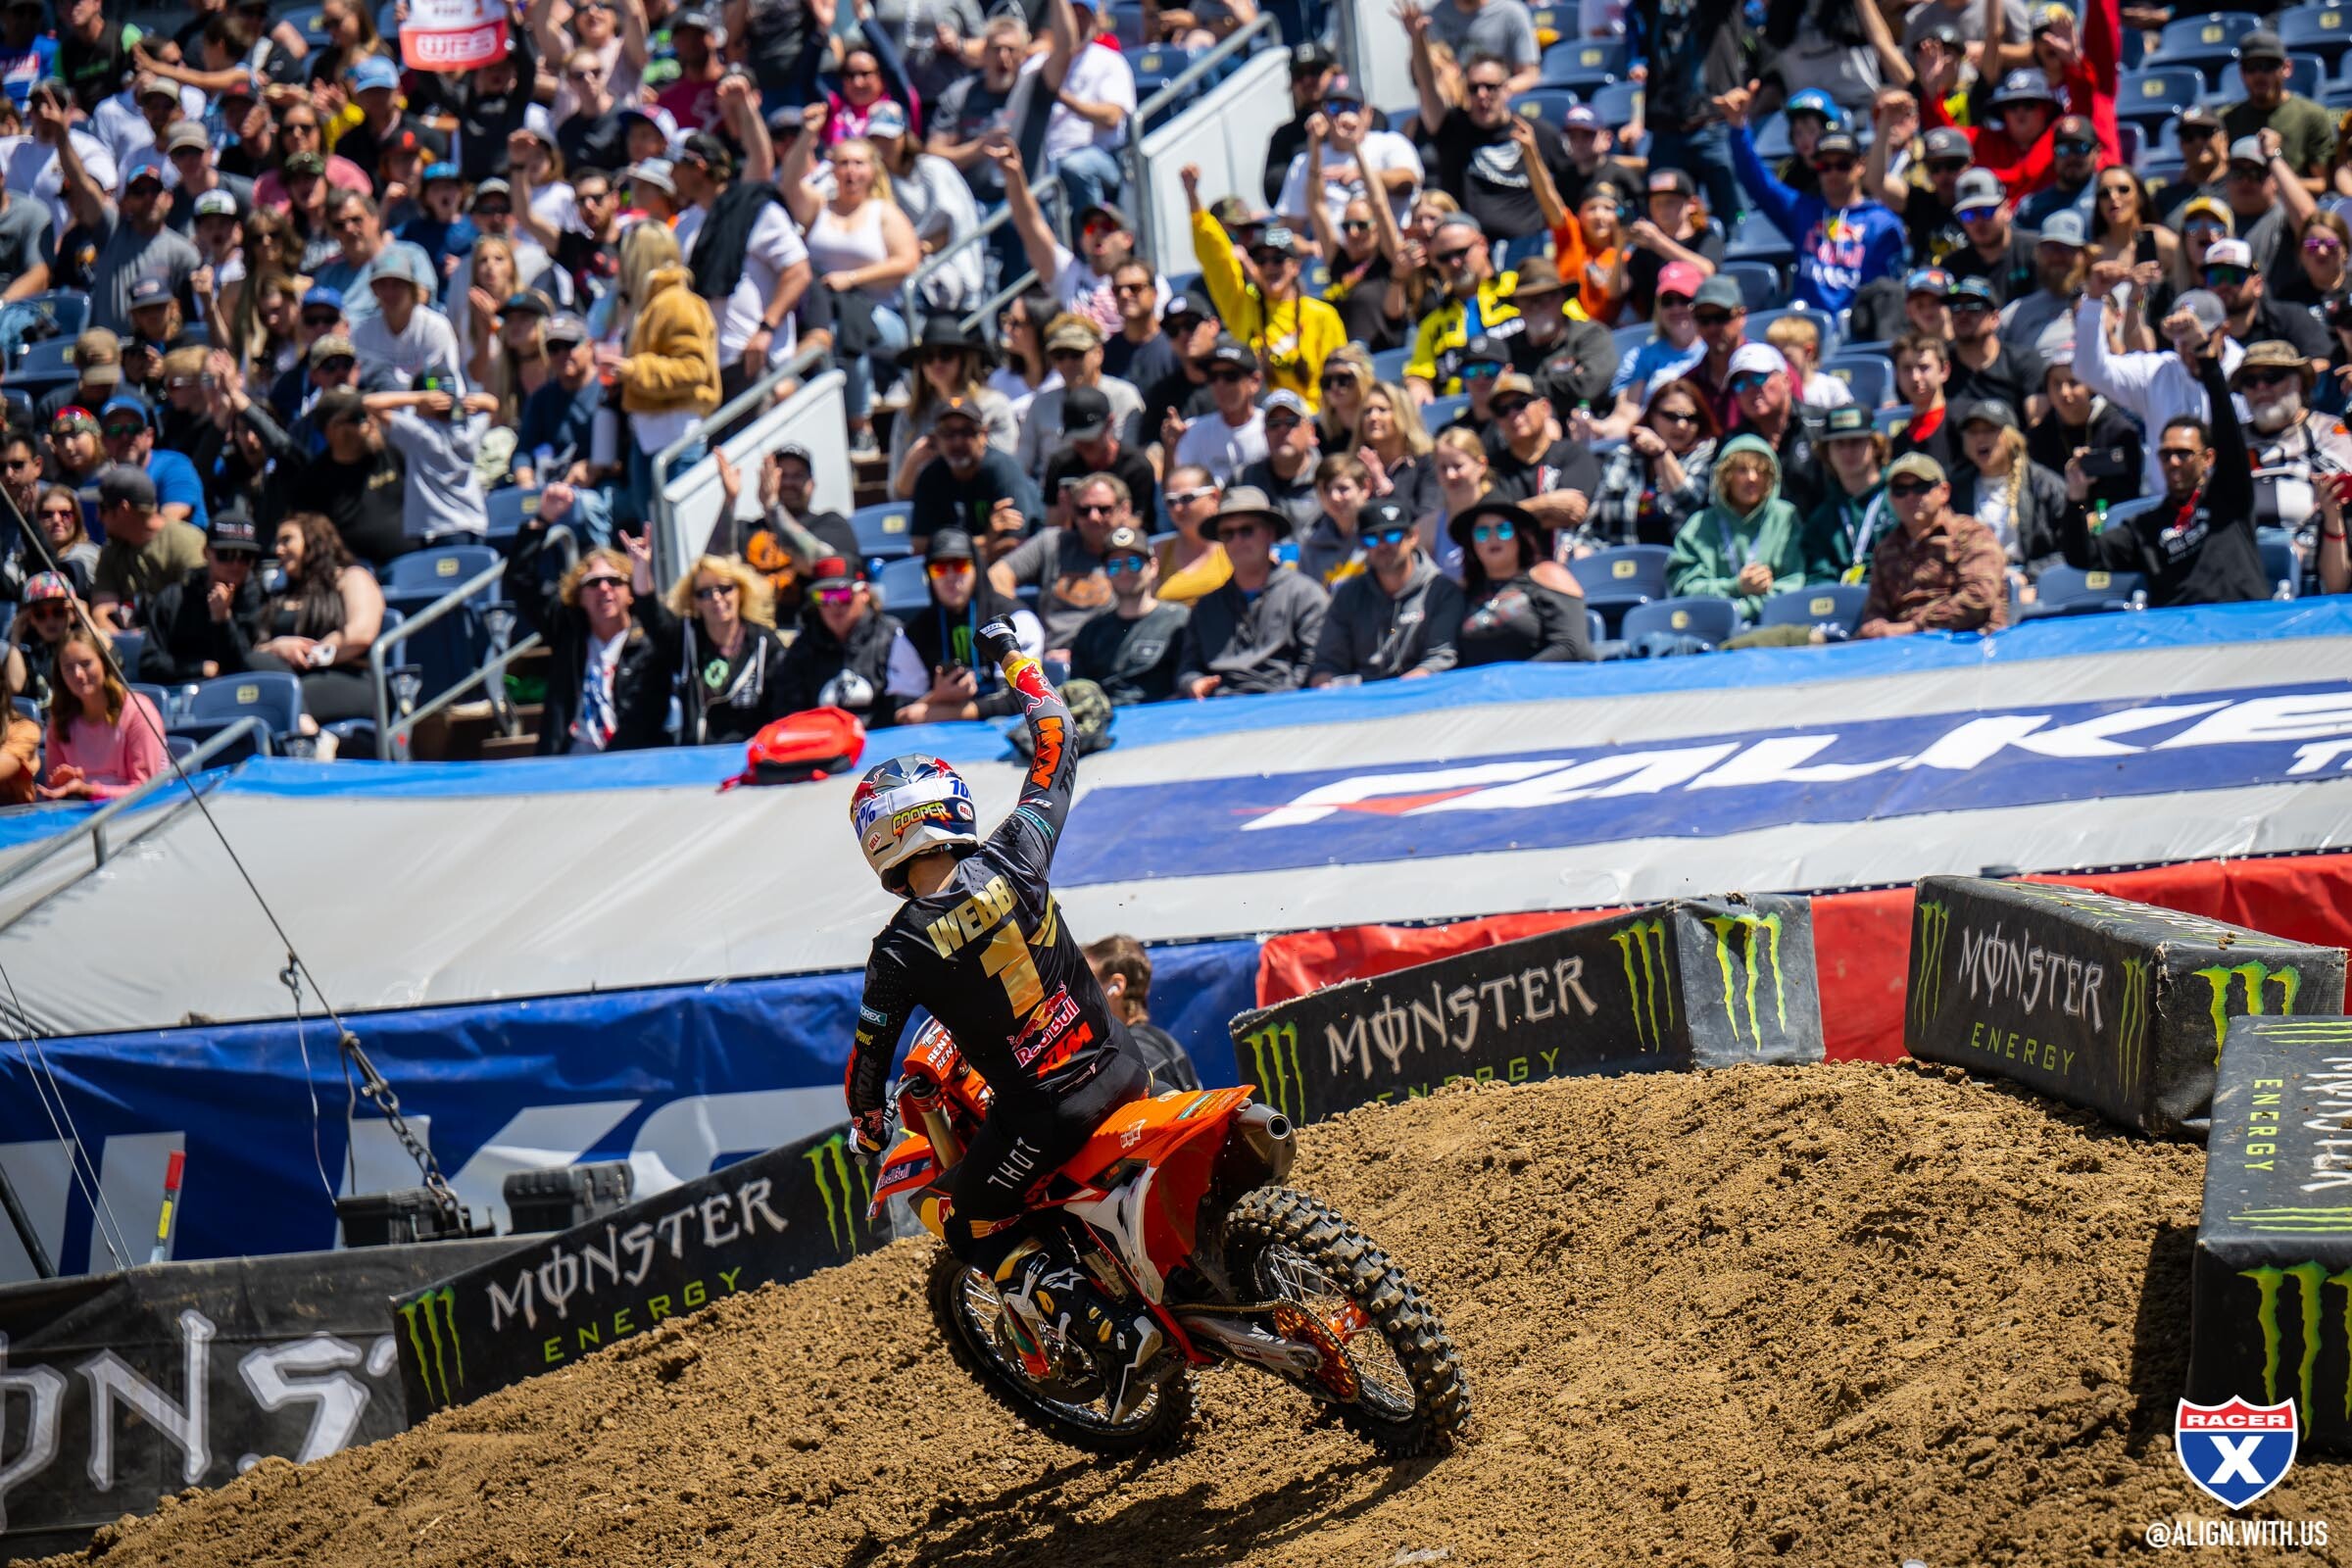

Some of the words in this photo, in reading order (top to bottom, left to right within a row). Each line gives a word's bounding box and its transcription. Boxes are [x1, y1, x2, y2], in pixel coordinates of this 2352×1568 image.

[892, 801, 954, 839] COOPER
[959, 804, 973, 818] BELL
[868, 833, 882, 851] BELL
[926, 875, 1018, 959] WEBB
[1037, 1020, 1094, 1079] KTM
[1971, 1021, 2075, 1076] ENERGY
[2244, 1078, 2283, 1171] ENERGY
[544, 1266, 743, 1363] ENERGY
